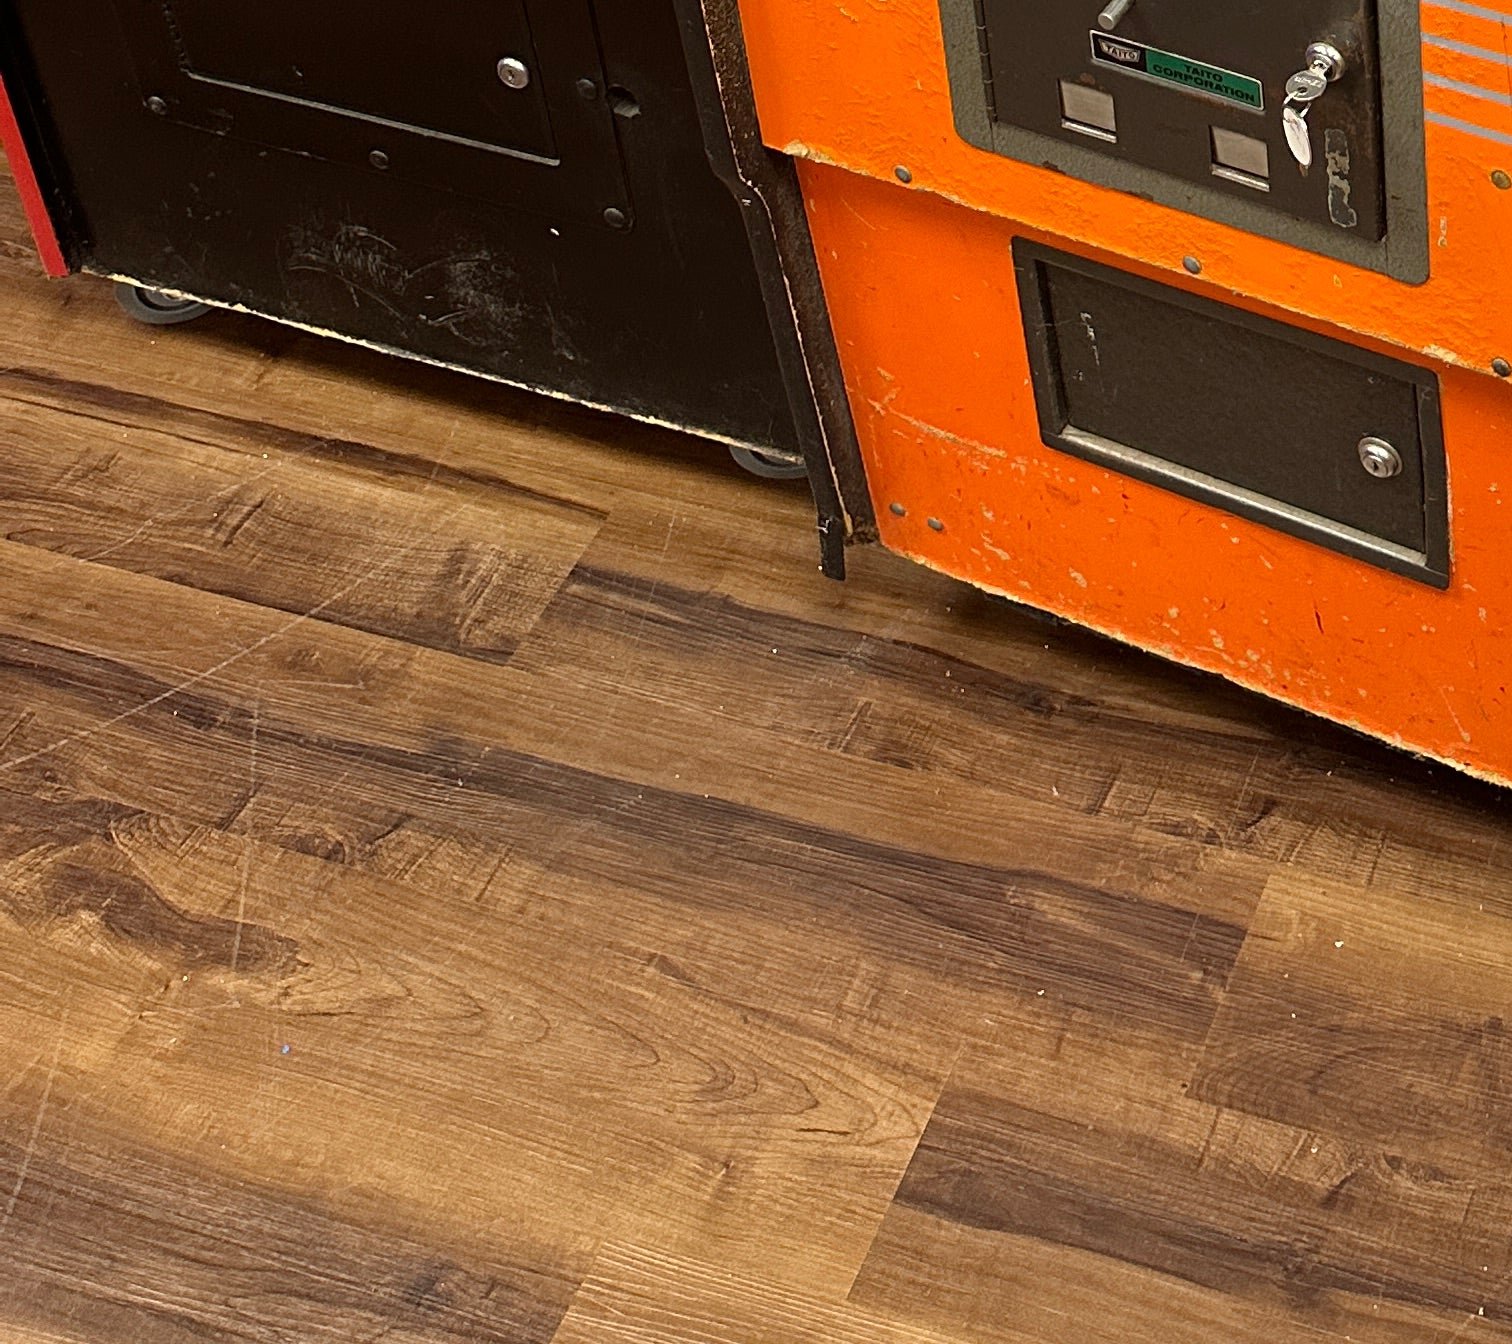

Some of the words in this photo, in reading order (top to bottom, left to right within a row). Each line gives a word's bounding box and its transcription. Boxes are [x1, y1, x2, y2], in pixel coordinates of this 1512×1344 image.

[1104, 45, 1137, 62] TAITO
[1152, 63, 1255, 103] CORPORATION
[1184, 63, 1223, 83] TAITO
